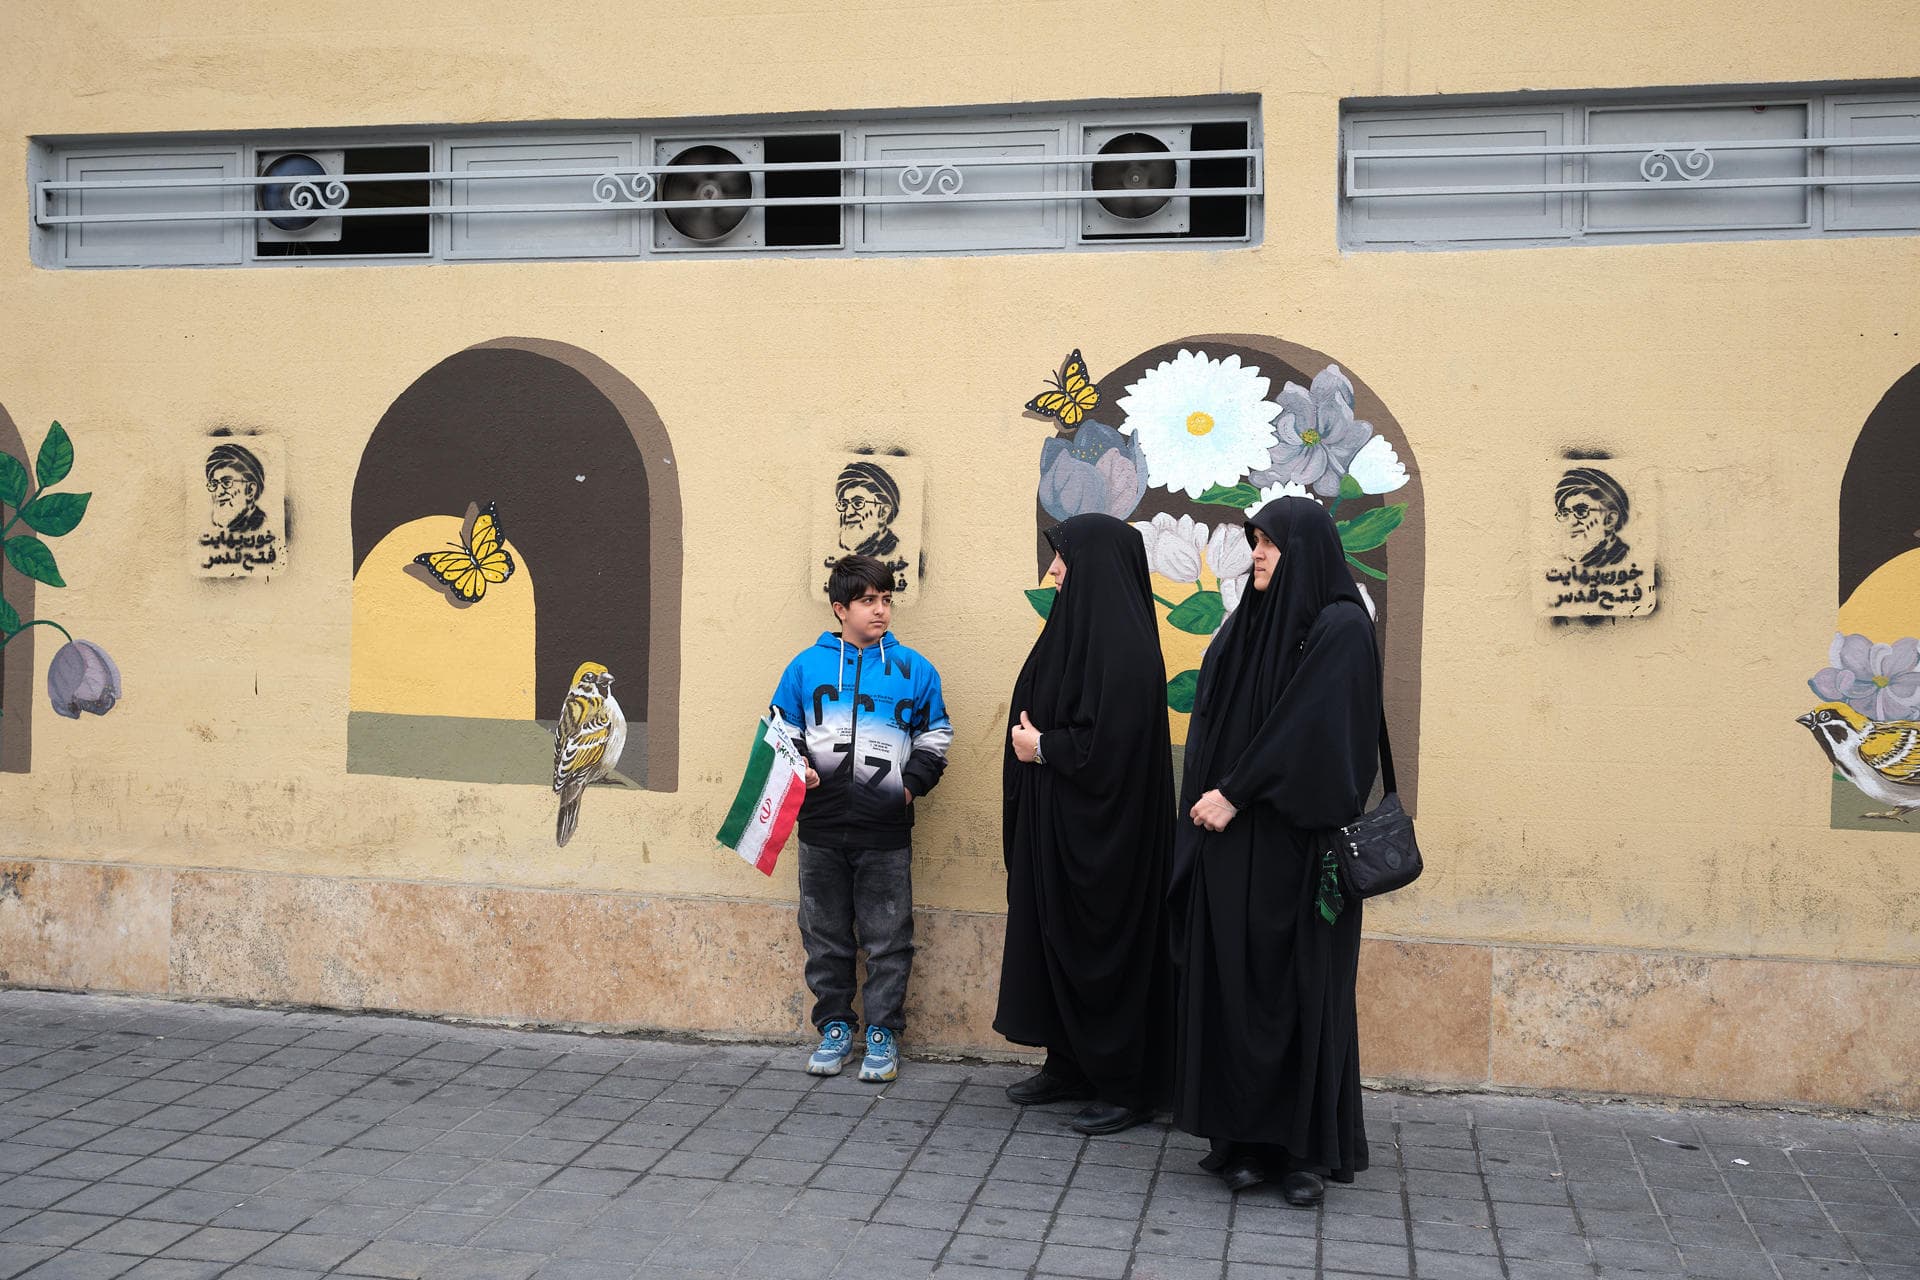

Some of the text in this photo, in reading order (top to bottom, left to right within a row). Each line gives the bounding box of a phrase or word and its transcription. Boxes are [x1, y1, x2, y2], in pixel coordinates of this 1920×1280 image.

[201, 545, 276, 571] فتح قدس
[1554, 583, 1642, 610] فتح قدس
